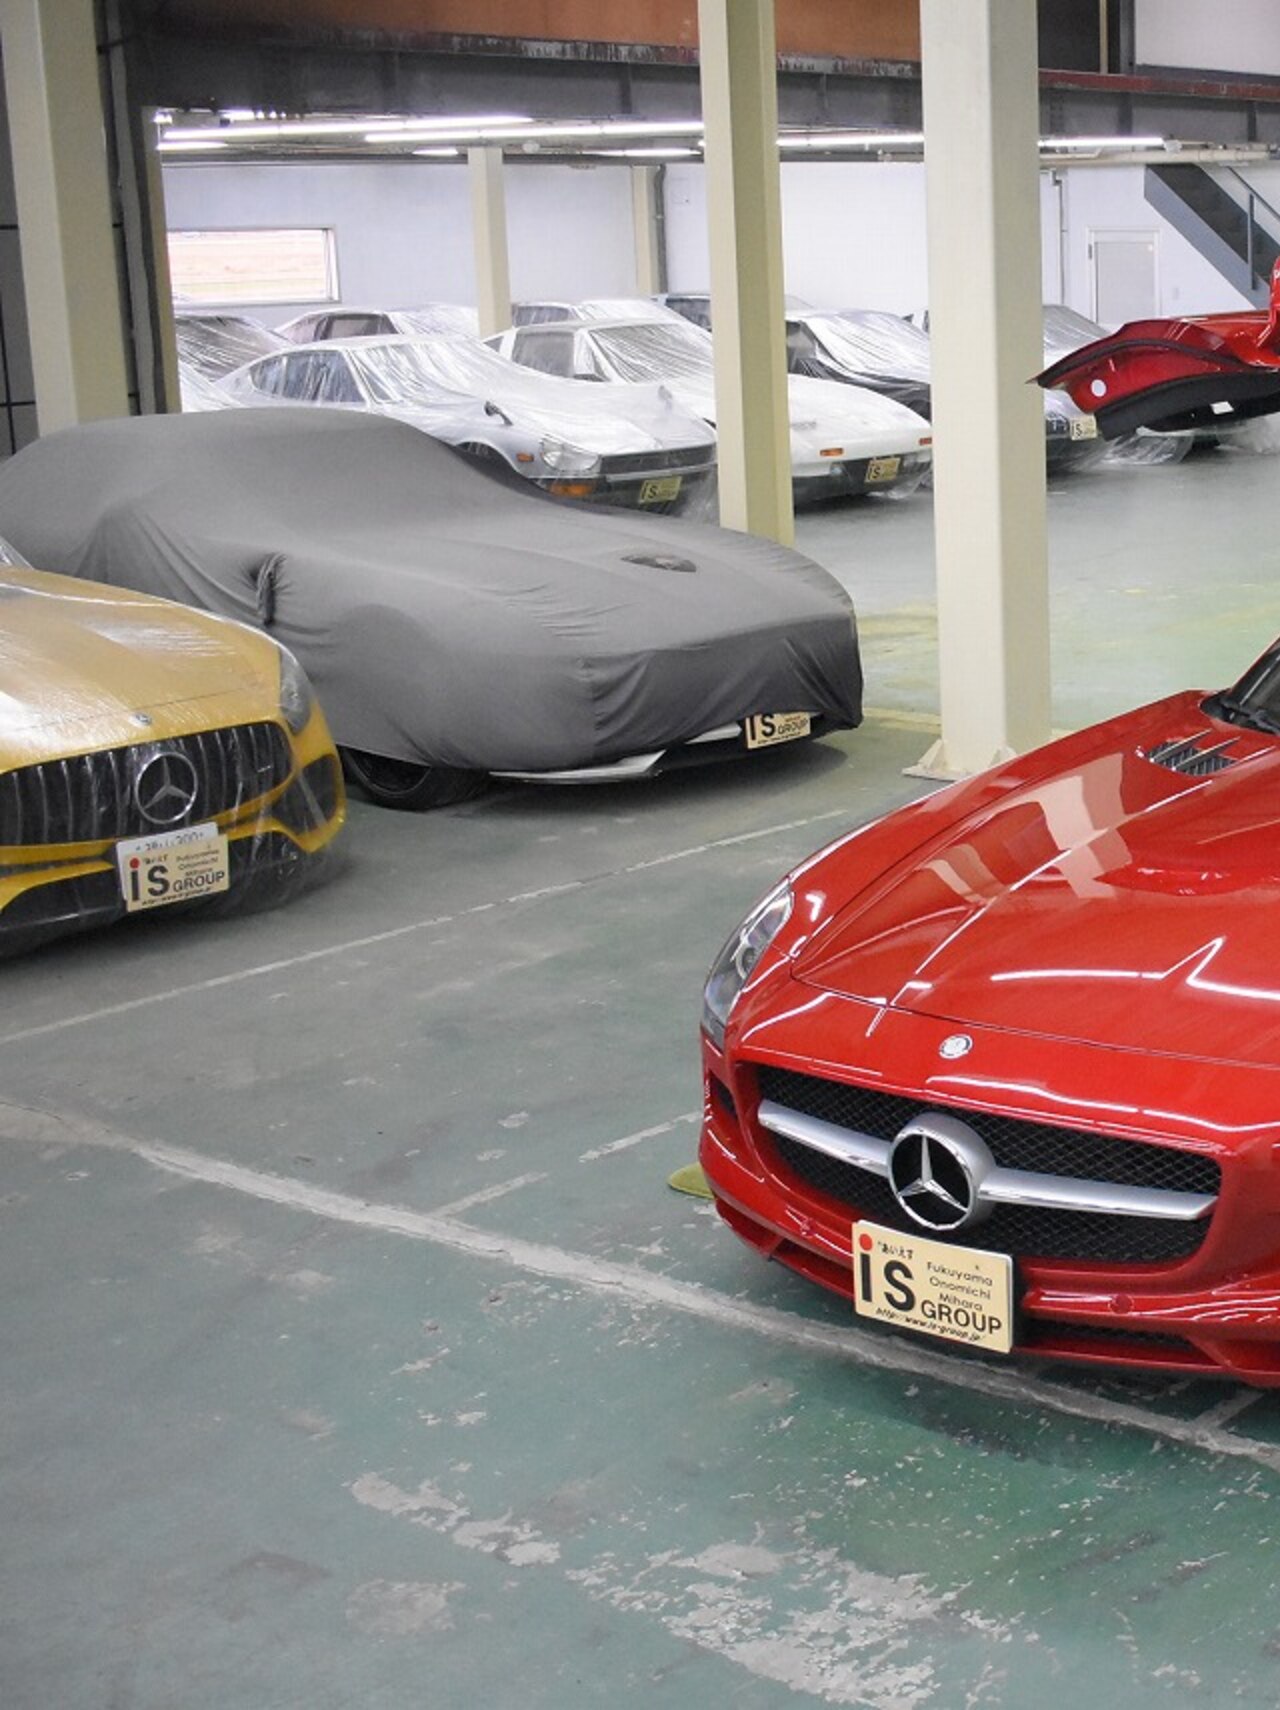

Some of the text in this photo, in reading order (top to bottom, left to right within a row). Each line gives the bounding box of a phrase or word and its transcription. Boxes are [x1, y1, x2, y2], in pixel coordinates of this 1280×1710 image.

[172, 870, 225, 893] GROUP
[926, 1261, 993, 1287] Fukuyama
[929, 1276, 991, 1300] Onomichi
[939, 1292, 983, 1312] Mihara
[921, 1299, 1002, 1335] GROUP
